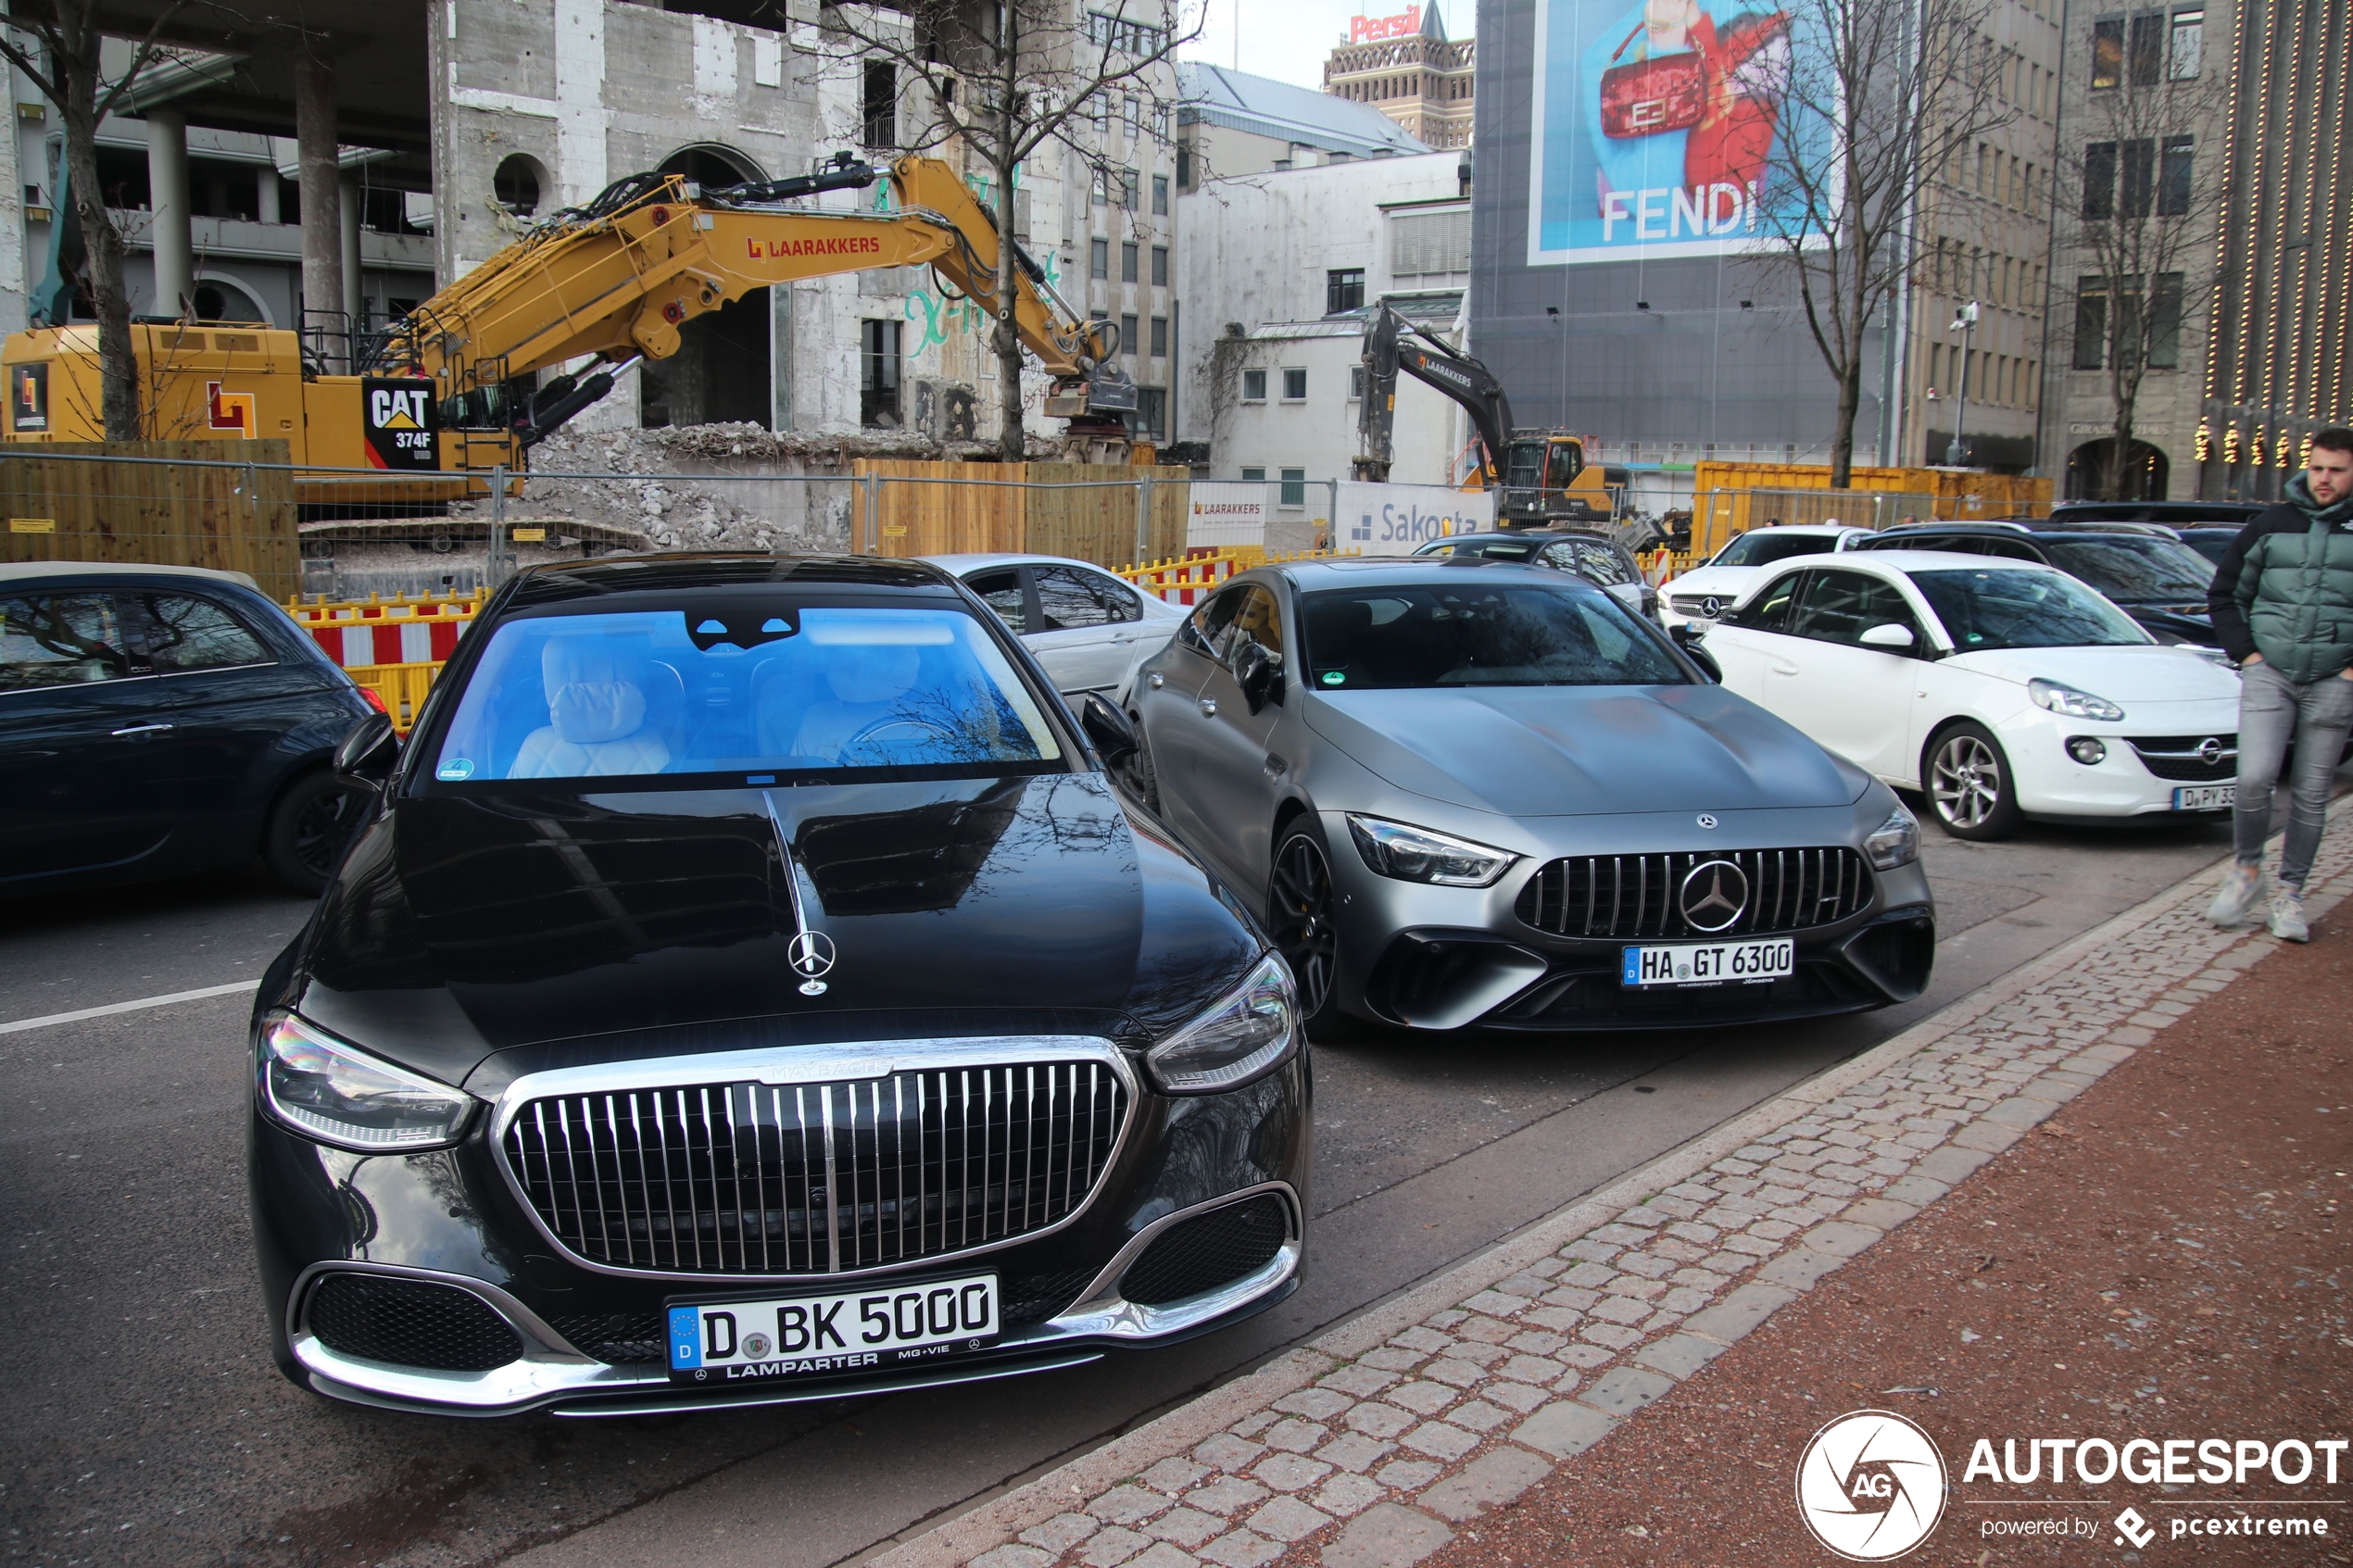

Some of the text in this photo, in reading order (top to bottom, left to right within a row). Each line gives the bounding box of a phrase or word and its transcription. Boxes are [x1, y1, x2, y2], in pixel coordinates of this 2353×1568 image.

[1351, 4, 1420, 44] Persil
[1603, 181, 1757, 242] FENDI
[769, 236, 880, 257] LAARAKKERS
[1427, 358, 1472, 387] LAARAKKERS
[371, 389, 429, 429] CAT
[396, 432, 431, 448] 374F
[1204, 504, 1261, 515] LAARAKKERS
[2185, 787, 2236, 807] D PY 33
[1642, 950, 1673, 980] HA
[1694, 947, 1725, 977] GT
[1732, 943, 1791, 974] 6300
[772, 1060, 879, 1081] MAYBACH
[679, 1344, 692, 1360] D
[702, 1311, 738, 1361] D
[776, 1299, 847, 1354] BK
[859, 1282, 989, 1344] 5000
[726, 1344, 950, 1380] LAMPARTER MG+VIE
